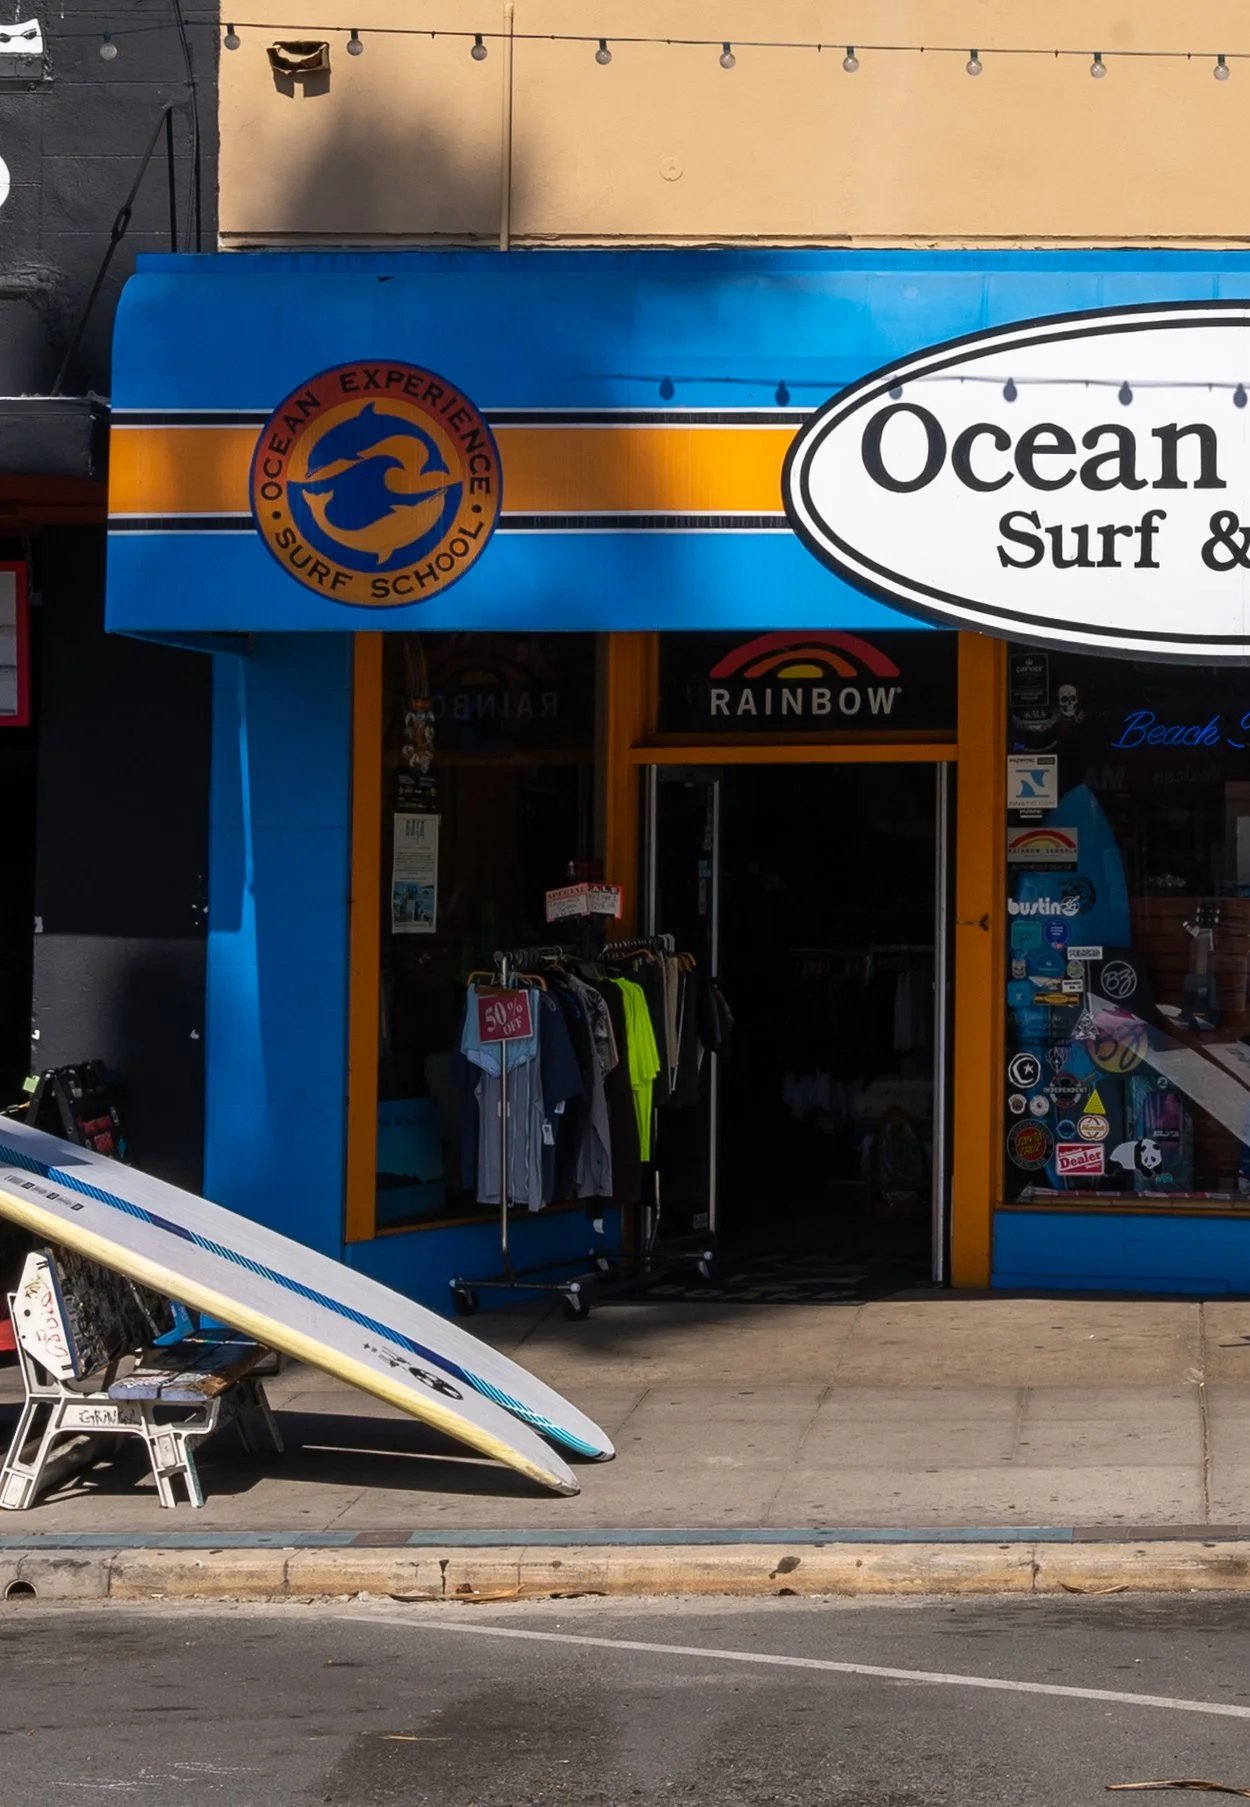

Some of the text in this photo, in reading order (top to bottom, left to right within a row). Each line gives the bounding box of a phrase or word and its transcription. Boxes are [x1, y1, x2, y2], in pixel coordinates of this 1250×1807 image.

[261, 368, 491, 501] OCEAN EXPERIENCE
[861, 402, 1227, 493] Ocean
[996, 509, 1167, 569] Surf
[275, 521, 485, 598] SURF SCHOOL
[710, 687, 897, 716] RAINBOW
[1110, 709, 1223, 749] Beach
[1007, 896, 1062, 916] bustin
[485, 998, 524, 1033] 50%
[503, 1016, 522, 1035] OFF
[1059, 1150, 1102, 1169] Dealer
